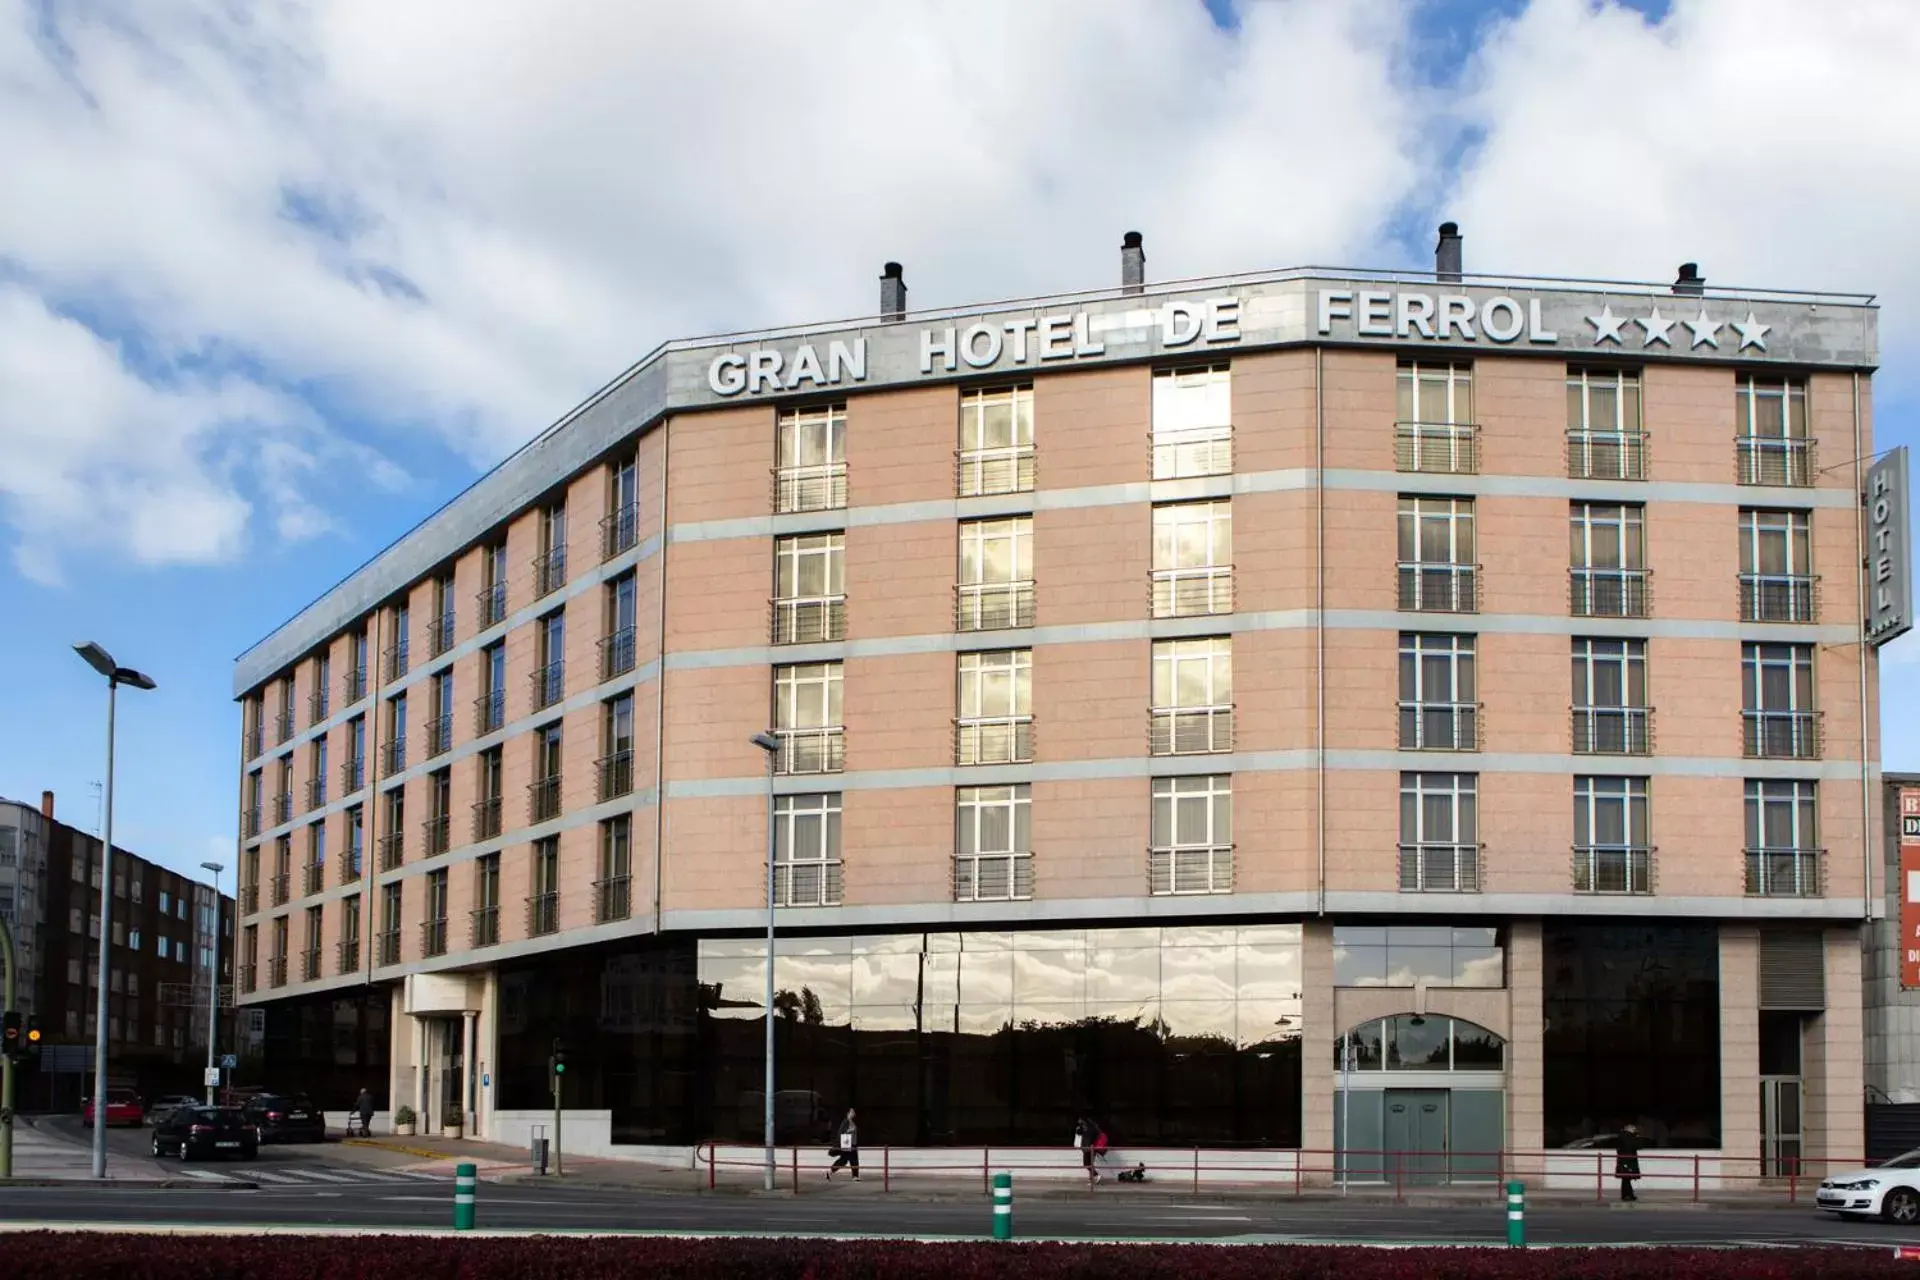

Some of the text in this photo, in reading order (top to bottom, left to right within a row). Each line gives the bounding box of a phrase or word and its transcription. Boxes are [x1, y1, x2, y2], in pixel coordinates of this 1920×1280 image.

[708, 289, 1558, 396] GRAN HOTEL DE FERROL
[1873, 469, 1891, 612] HOTEL
